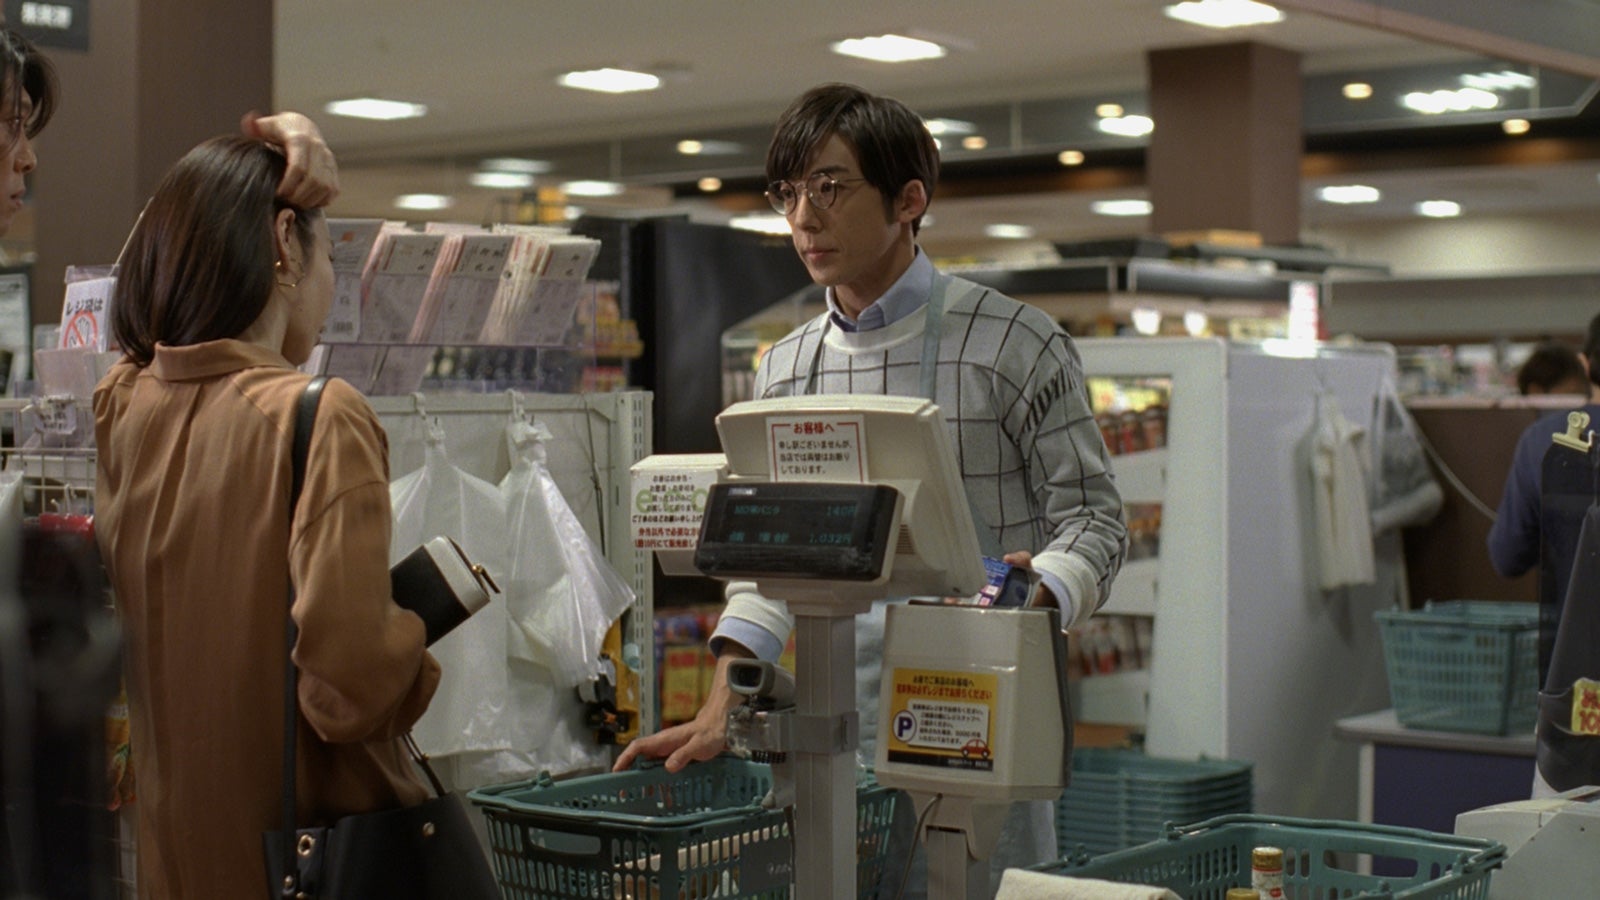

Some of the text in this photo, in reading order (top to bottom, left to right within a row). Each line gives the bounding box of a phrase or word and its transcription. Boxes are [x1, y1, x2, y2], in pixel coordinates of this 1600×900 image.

[793, 421, 835, 434] お客様へ
[779, 440, 852, 449] 申し訳ございませんが、
[780, 453, 850, 462] 当店では両替はお断り
[781, 465, 826, 474] しております。
[897, 716, 913, 738] P
